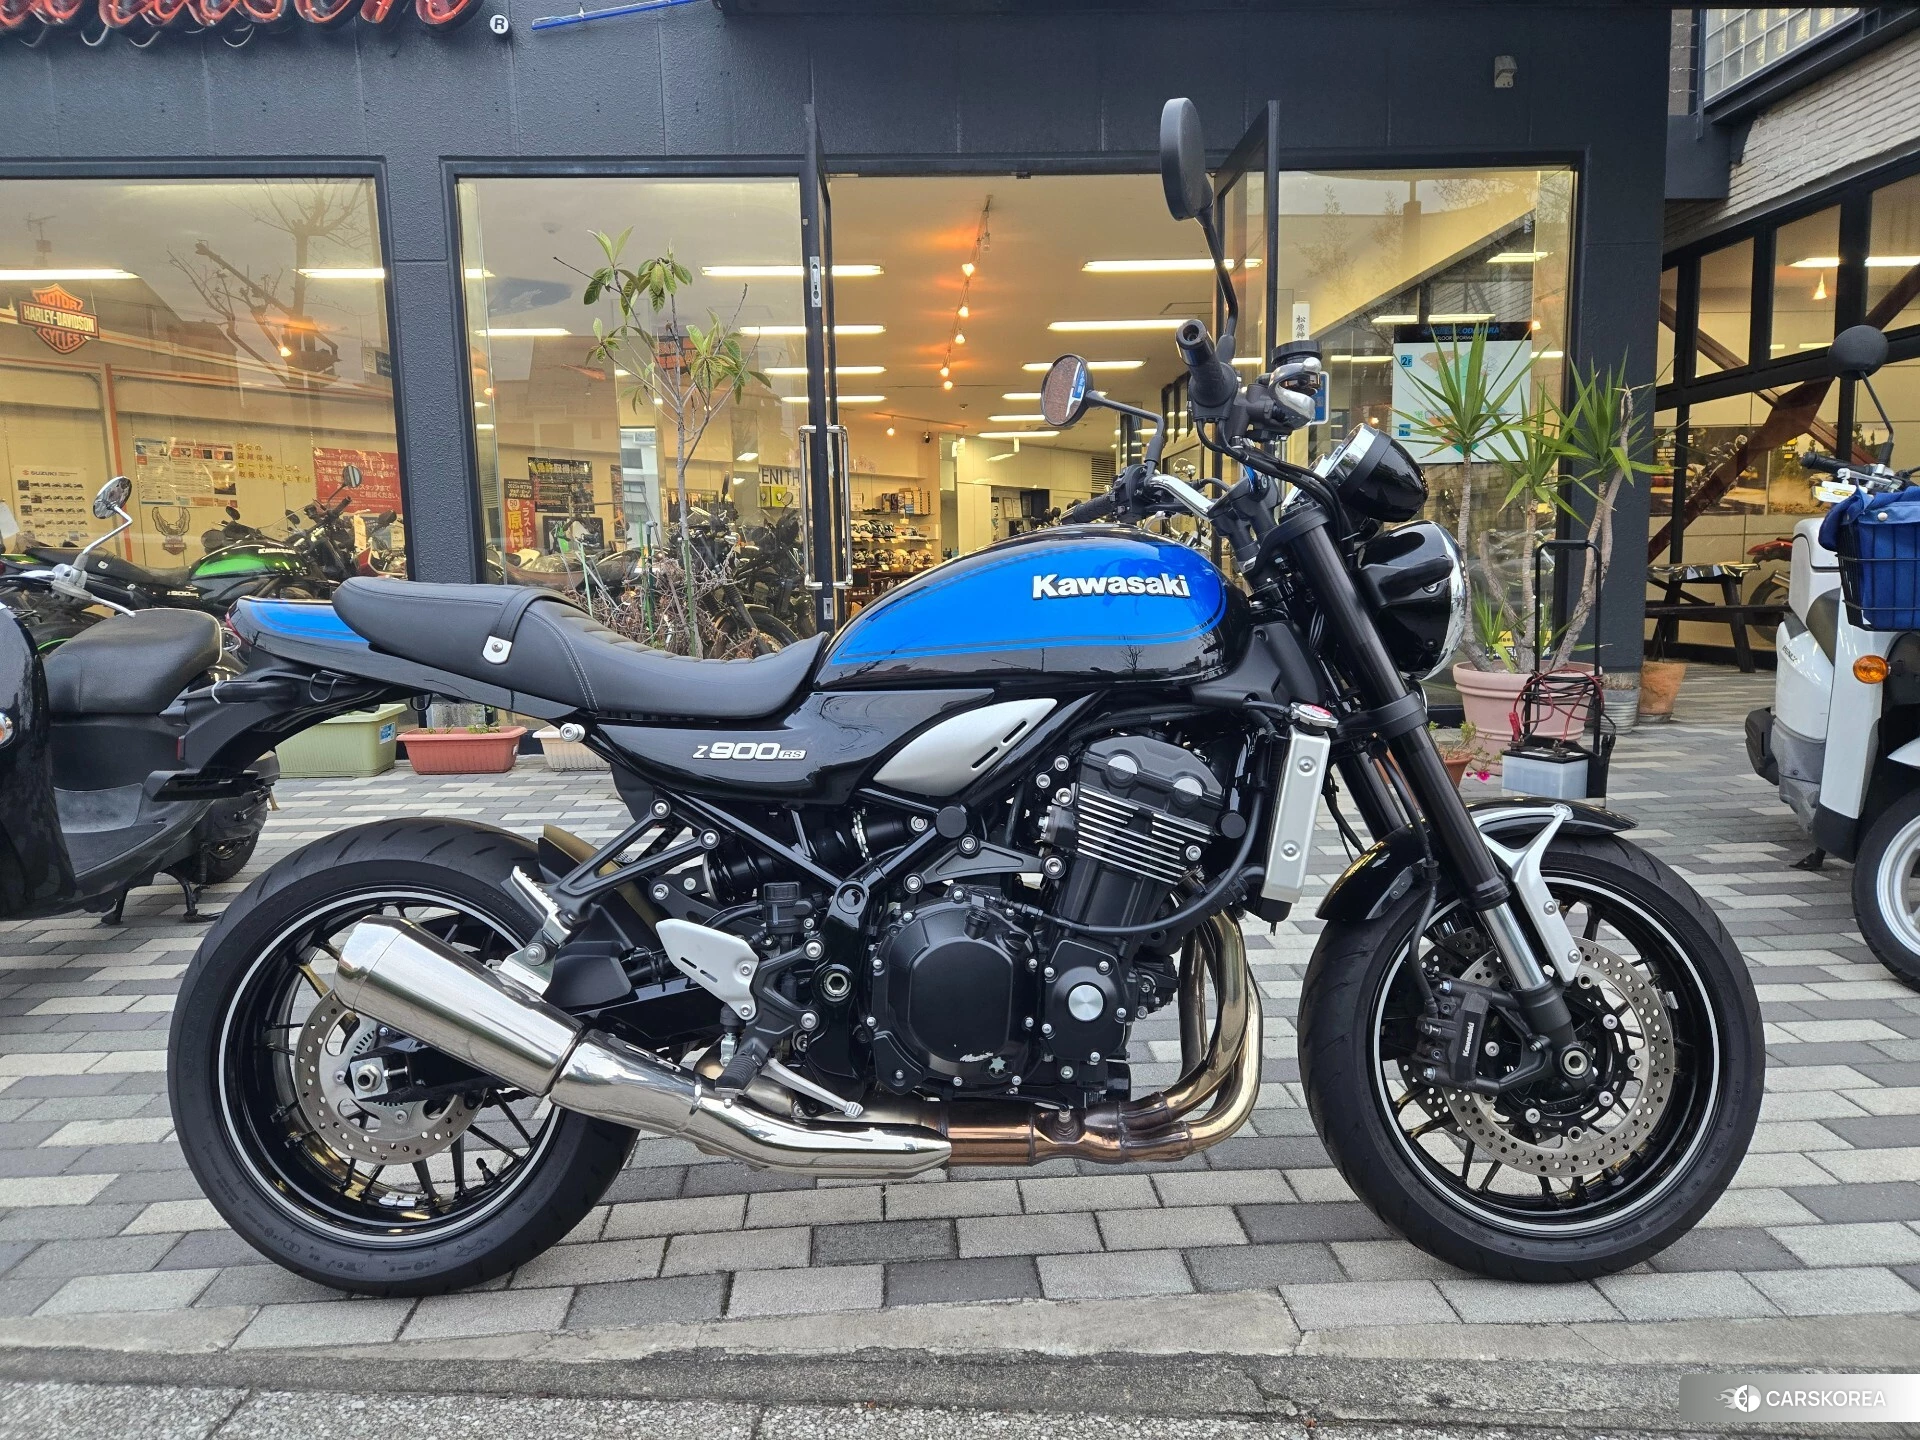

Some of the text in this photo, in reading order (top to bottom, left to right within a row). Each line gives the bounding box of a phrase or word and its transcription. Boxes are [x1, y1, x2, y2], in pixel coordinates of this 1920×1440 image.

[39, 291, 78, 310] MOTOR
[23, 304, 95, 332] HARLEY-DAVIDSON
[42, 328, 80, 349] CYCLES
[1401, 356, 1412, 366] 2F
[759, 467, 800, 487] ENITH
[1032, 573, 1191, 600] Kawasaki
